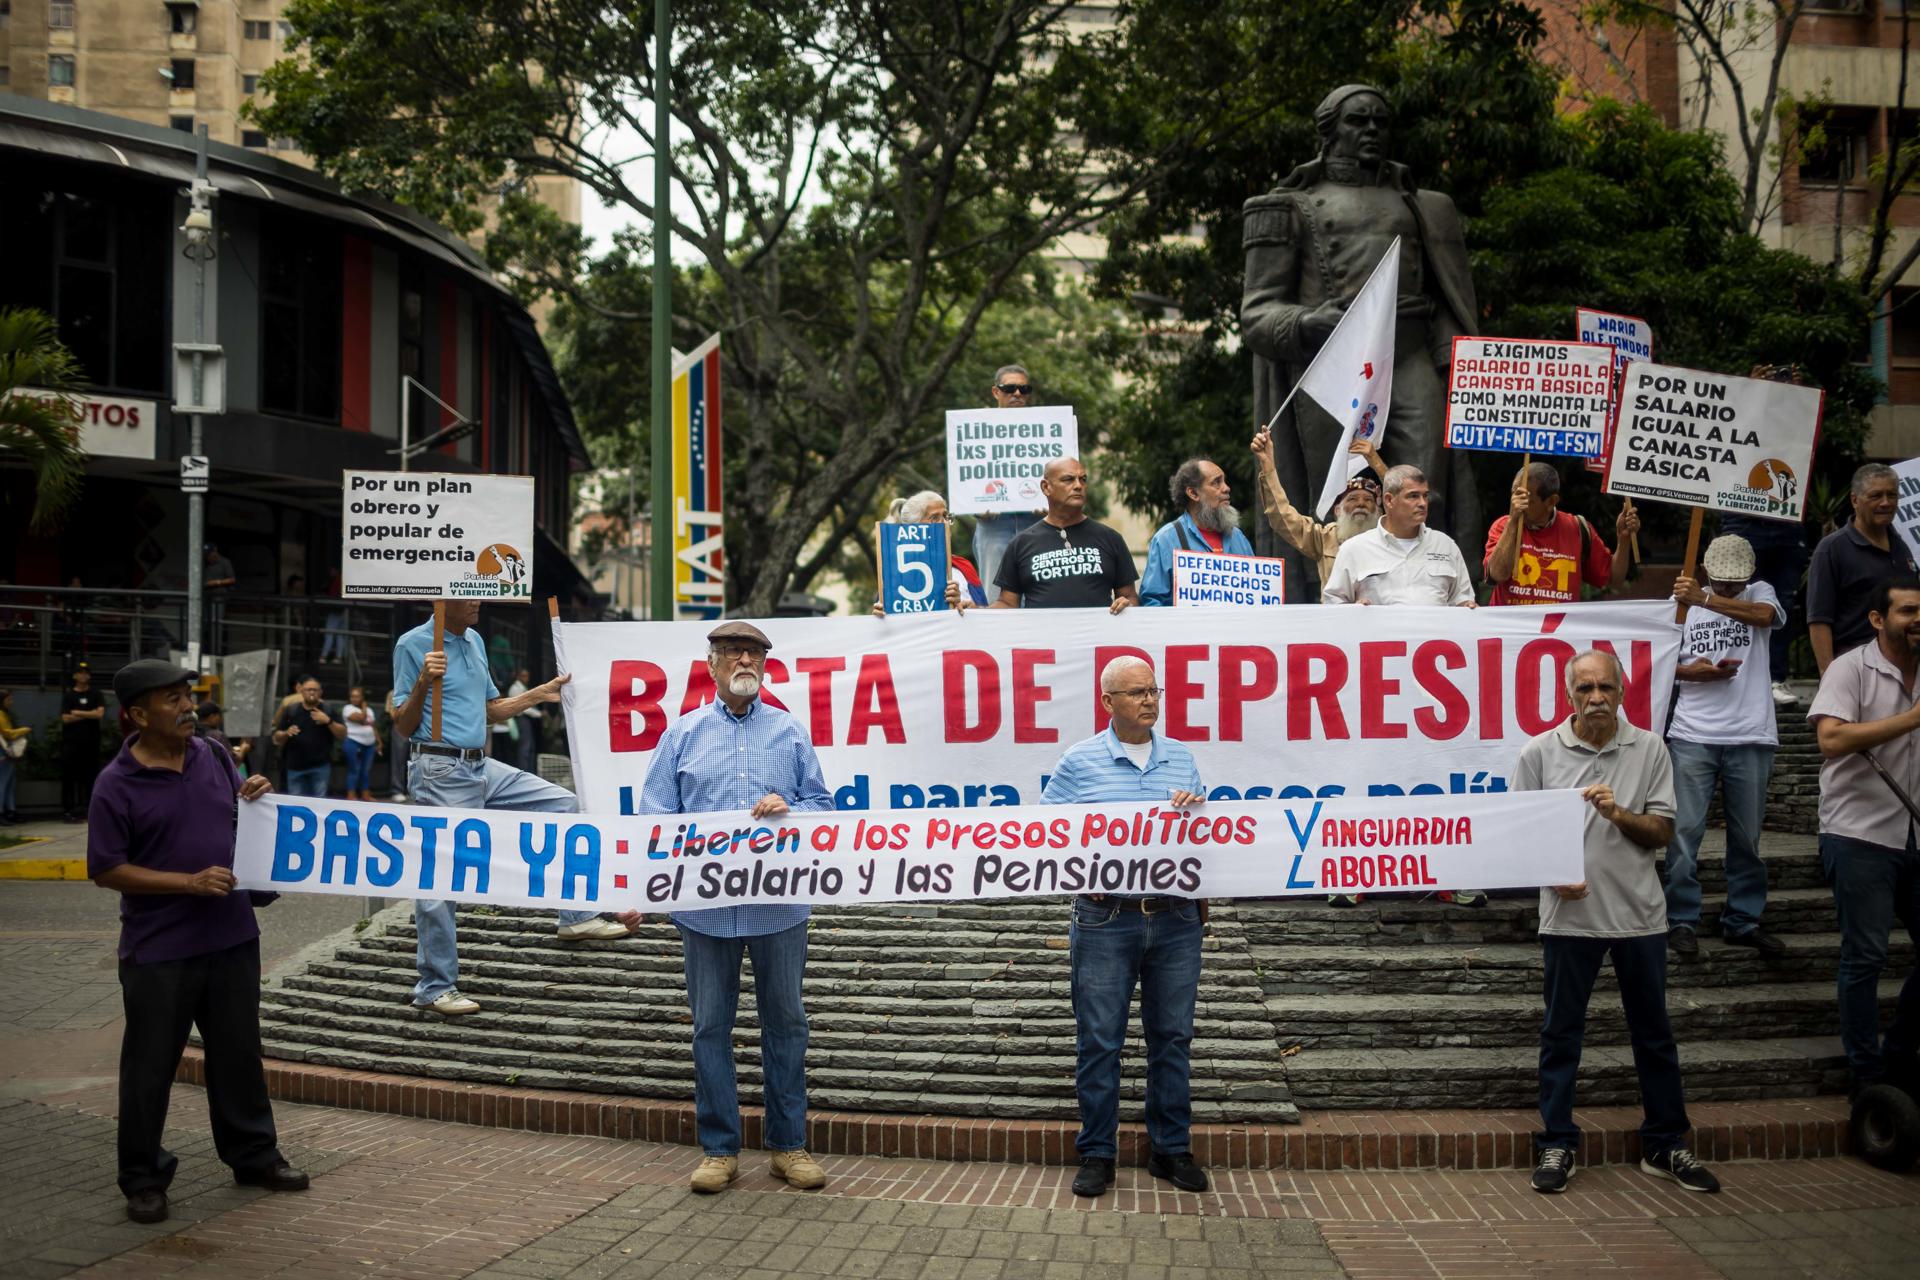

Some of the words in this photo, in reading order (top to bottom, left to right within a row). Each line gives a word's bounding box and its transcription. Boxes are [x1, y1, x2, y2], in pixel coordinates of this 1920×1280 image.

[1598, 317, 1636, 337] MARIA
[1483, 343, 1568, 360] EXIGIMOS
[1456, 359, 1529, 375] SALARIO
[1537, 363, 1592, 378] IGUAL
[1598, 365, 1608, 379] A
[1457, 375, 1534, 391] CANASTA
[1542, 378, 1605, 395] BASICA
[1638, 374, 1687, 395] POR
[1693, 381, 1726, 400] UN
[1450, 391, 1495, 406] COMO
[1503, 394, 1584, 411] MANDATA
[1591, 398, 1610, 413] LA
[1635, 394, 1736, 422] SALARIO
[1465, 407, 1591, 428] CONSTITUCIÓN
[956, 422, 1044, 442] ¡Liberen
[1050, 423, 1062, 438] a
[1632, 415, 1700, 439] IGUAL
[1706, 426, 1723, 442] A
[1730, 429, 1760, 447] LA
[991, 442, 1063, 460] presxs
[1628, 436, 1737, 465] CANASTA
[960, 460, 1044, 481] político
[1625, 455, 1711, 482] BÁSICA
[351, 476, 387, 492] Por
[394, 480, 420, 492] un
[427, 478, 472, 496] plan
[1717, 492, 1767, 504] SOCIALISMO
[1725, 500, 1766, 512] LIBERTAD
[350, 499, 421, 515] obrero
[427, 504, 440, 519] y
[1767, 500, 1800, 517] PSL
[350, 523, 432, 540] popular
[438, 524, 464, 538] de
[897, 525, 931, 541] ART.
[350, 545, 475, 564] emergencia
[1031, 555, 1084, 570] CENTROS
[1087, 555, 1102, 563] DE
[1032, 547, 1077, 563] CIERREN
[1079, 547, 1099, 555] LOS
[896, 543, 934, 601] 5
[1032, 563, 1103, 581] TORTURA
[1178, 556, 1250, 573] DEFENDER
[1255, 563, 1280, 577] LOS
[500, 583, 532, 597] PSL
[1191, 572, 1270, 591] DERECHOS
[893, 599, 935, 613] CRBV
[1179, 587, 1254, 605] HUMANOS
[1691, 630, 1710, 642] LOS
[942, 648, 1059, 744] DE
[1284, 801, 1472, 852] VANGUARDIA
[270, 804, 491, 894] BASTA
[647, 823, 800, 860] Liberen
[811, 824, 840, 851] a
[854, 819, 911, 851] los
[646, 864, 684, 902] el
[696, 859, 843, 899] Salario
[858, 858, 875, 895] y
[895, 858, 954, 896] las
[1285, 854, 1437, 889] LABORAL
